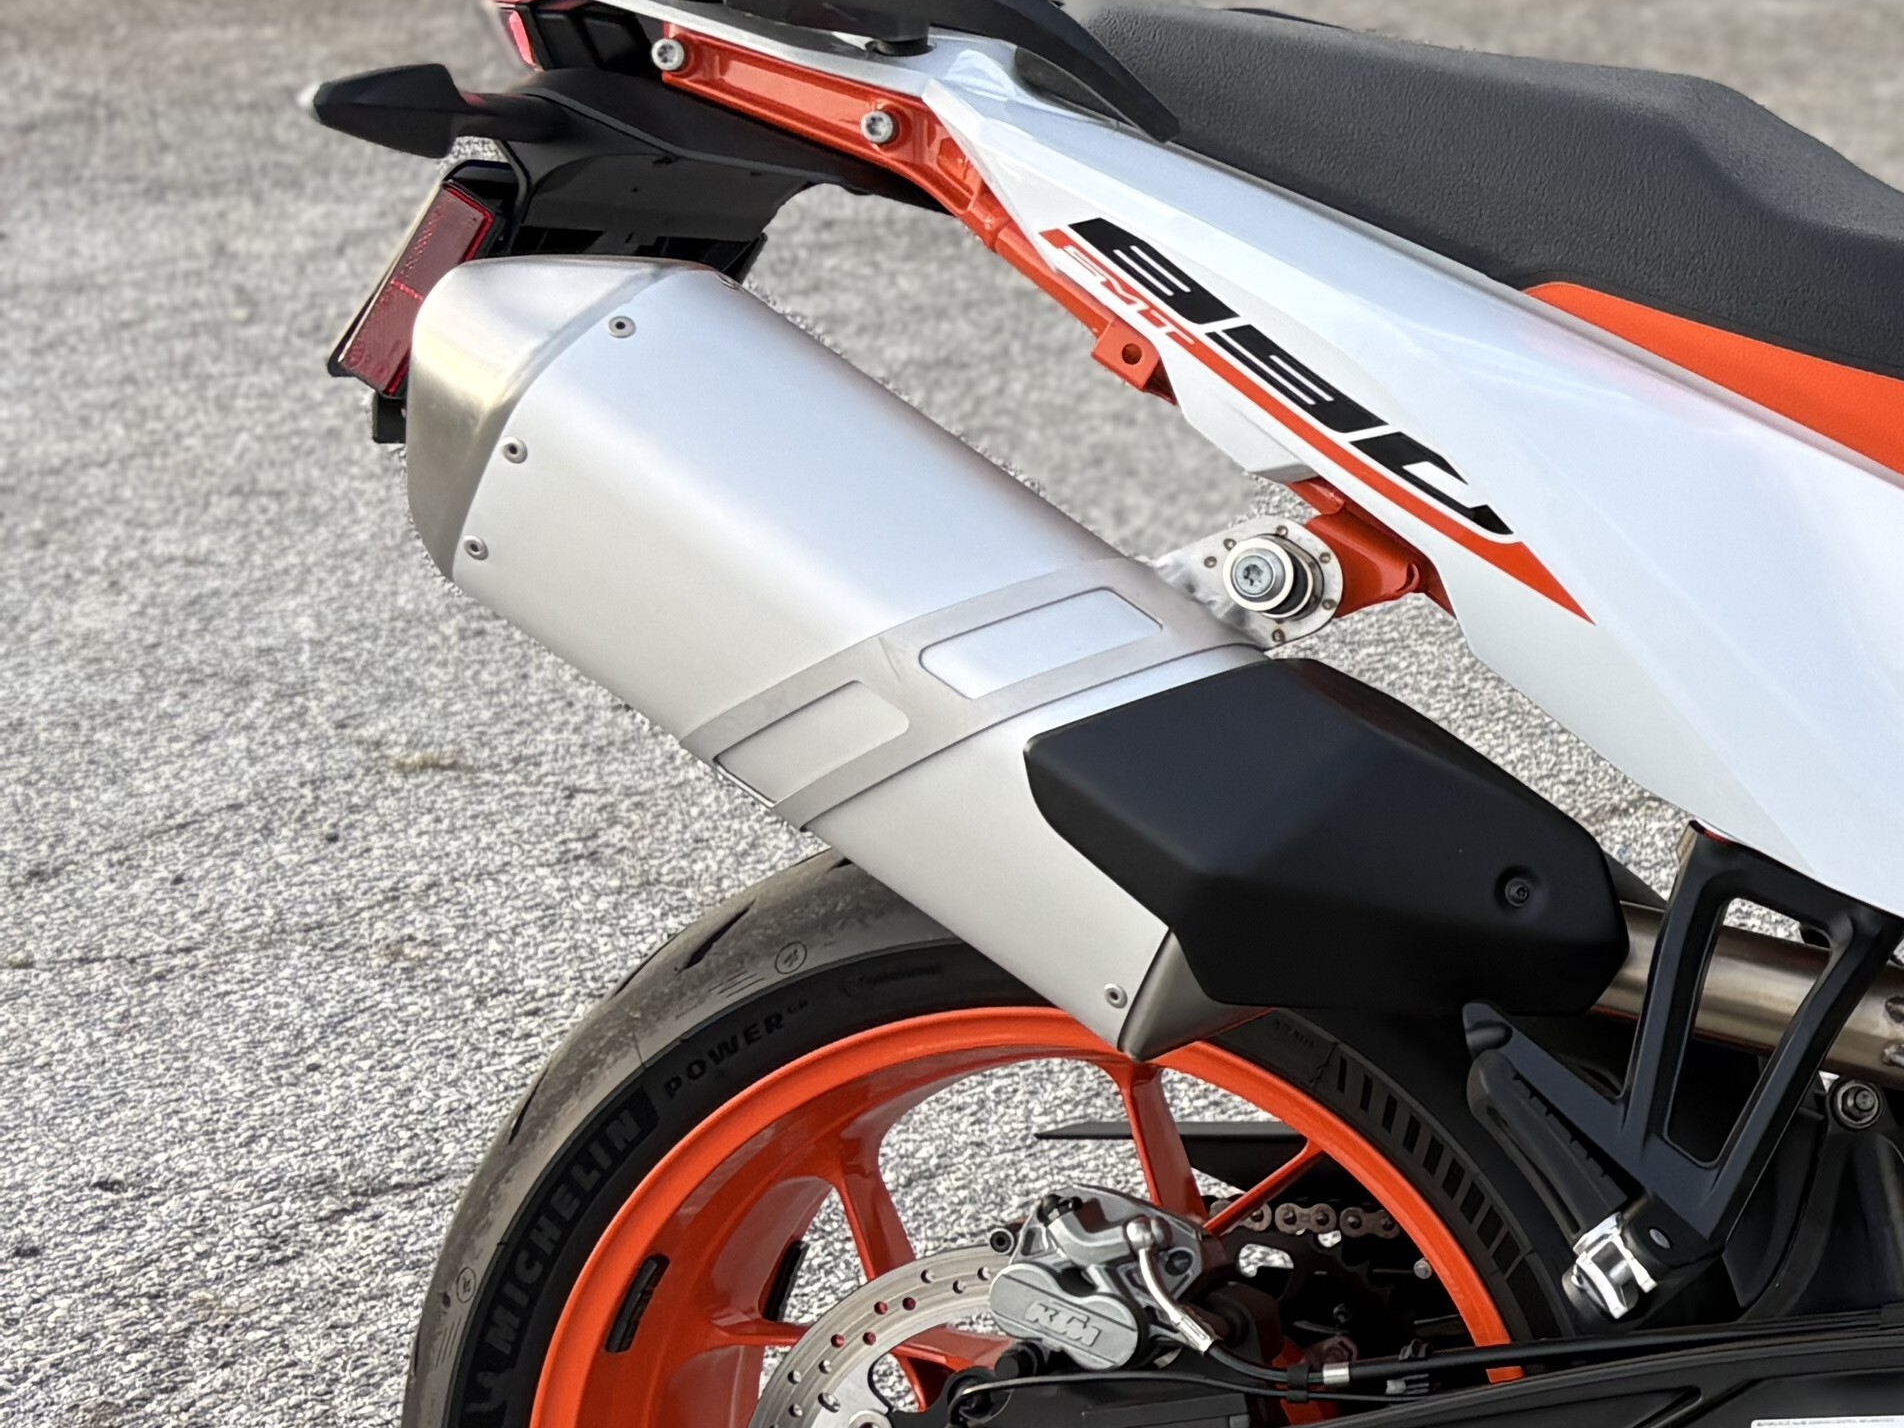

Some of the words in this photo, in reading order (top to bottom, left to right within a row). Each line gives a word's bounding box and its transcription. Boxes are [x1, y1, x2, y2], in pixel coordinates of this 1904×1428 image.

[663, 1008, 787, 1100] POWER
[481, 1107, 644, 1363] MICHELIN
[1022, 1300, 1102, 1347] KTM
